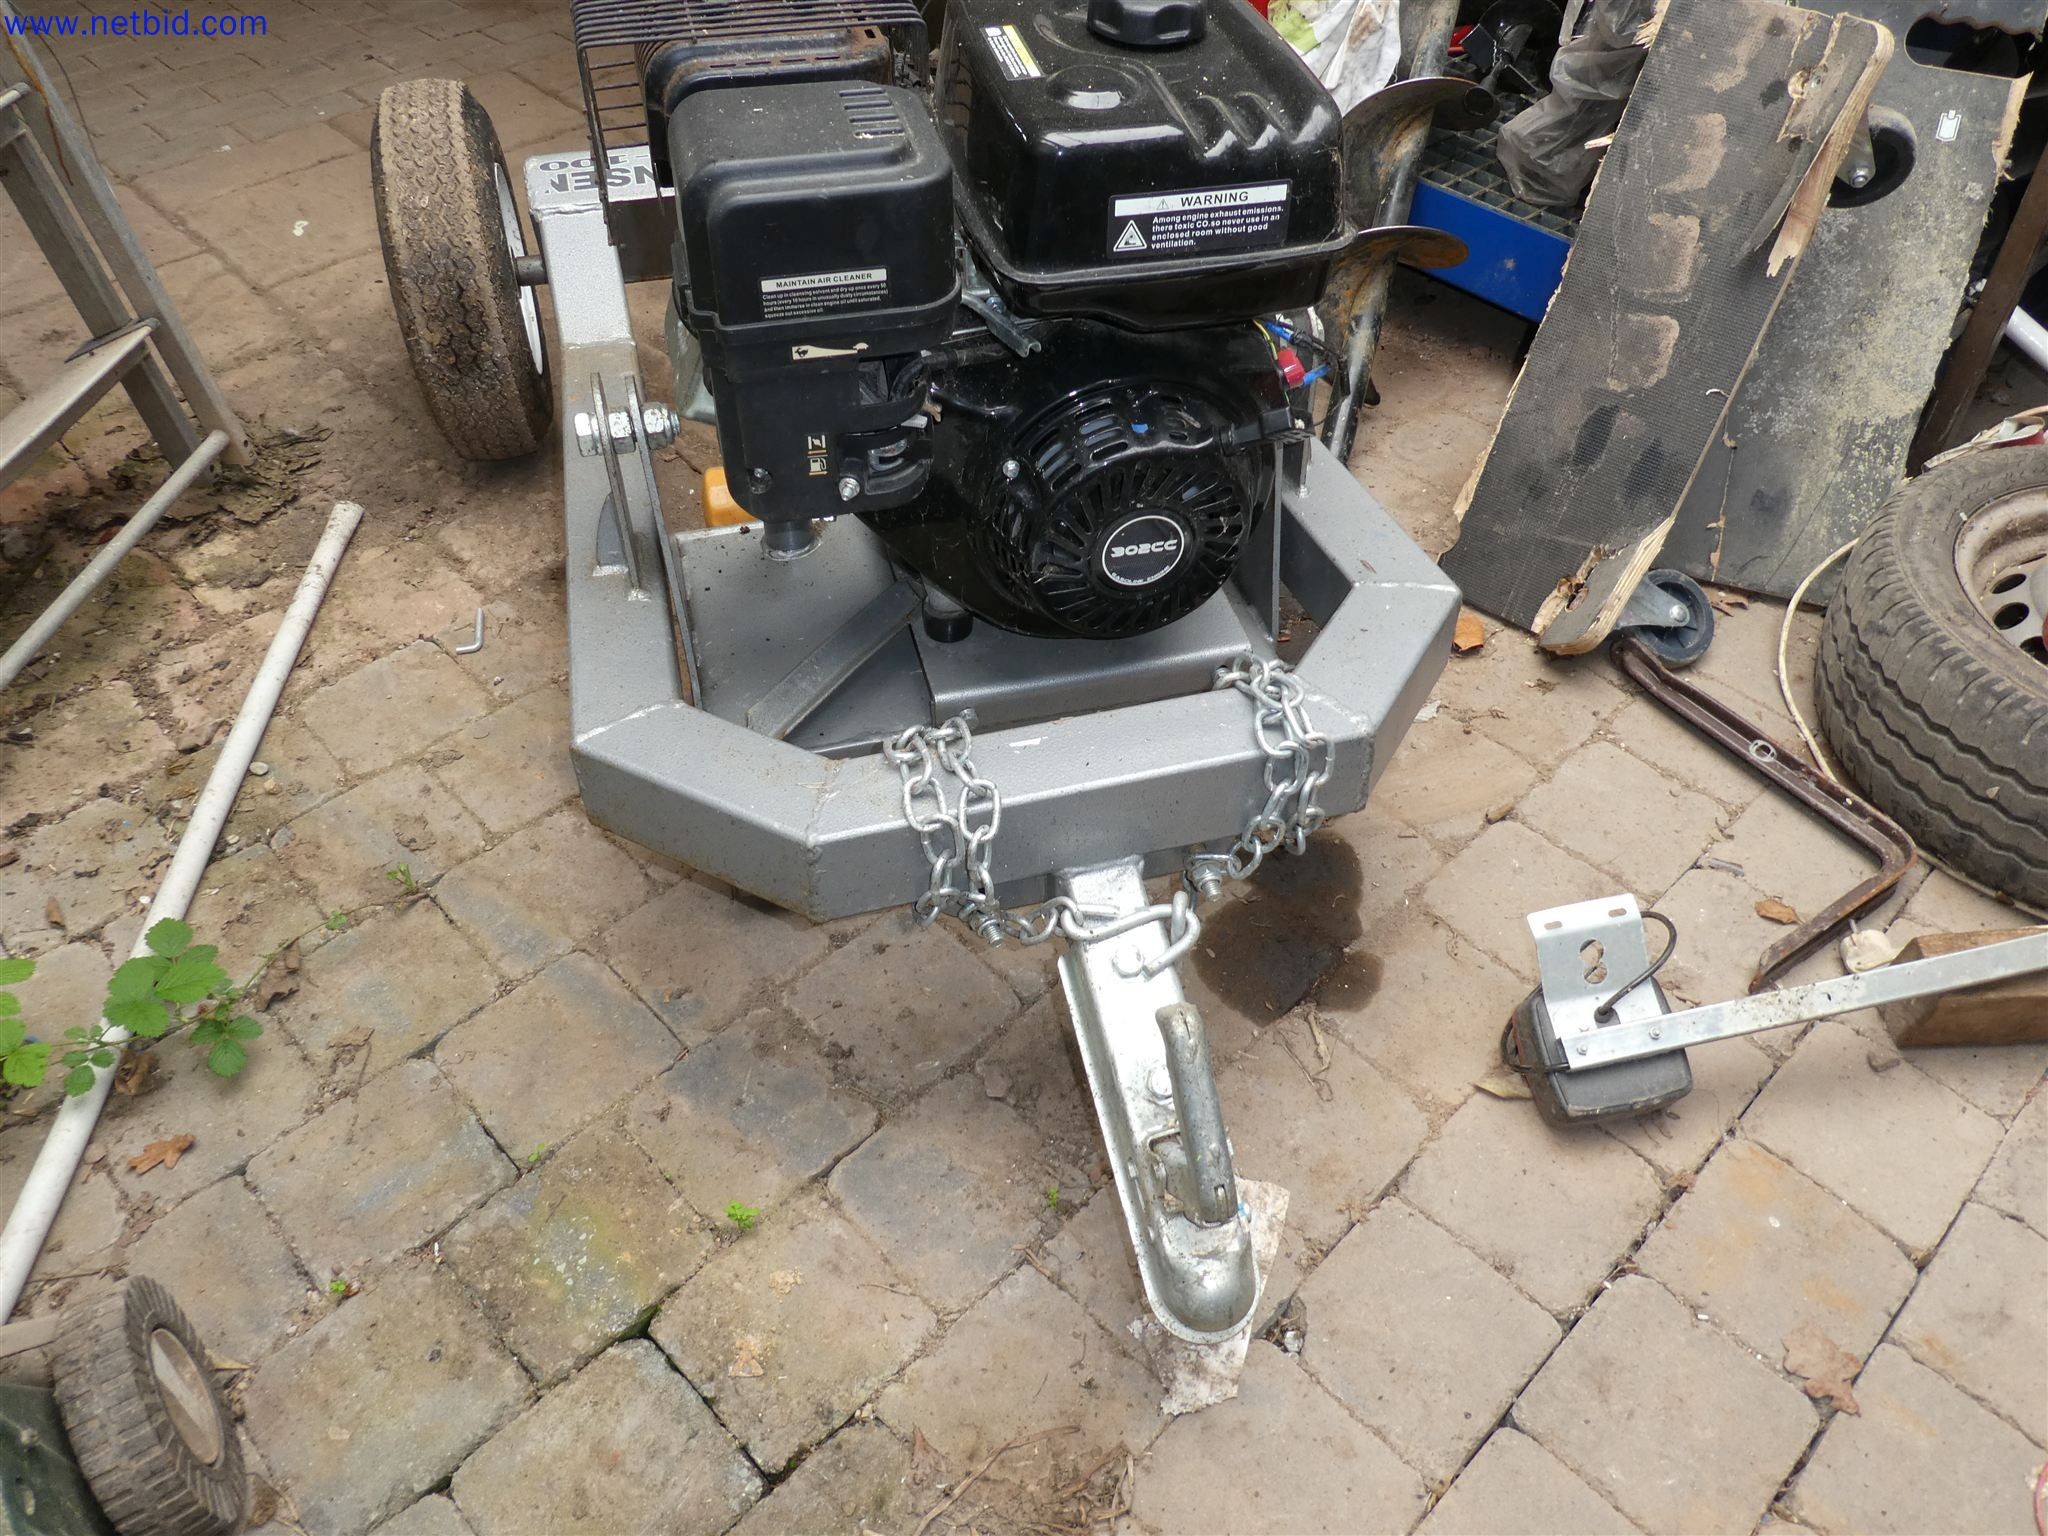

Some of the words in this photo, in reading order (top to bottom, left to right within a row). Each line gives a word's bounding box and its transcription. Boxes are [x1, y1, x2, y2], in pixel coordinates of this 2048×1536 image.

[1180, 192, 1248, 207] WARNING
[1175, 222, 1195, 230] toxic
[1261, 214, 1269, 222] in
[1182, 212, 1208, 222] engine
[1210, 209, 1241, 218] exhaust
[1152, 232, 1190, 241] enclosed
[1192, 229, 1212, 237] room
[1215, 226, 1246, 235] without
[1248, 223, 1268, 233] good
[1151, 239, 1196, 249] ventilation.
[776, 279, 815, 288] MAINTAIN
[833, 273, 872, 282] CLEANER
